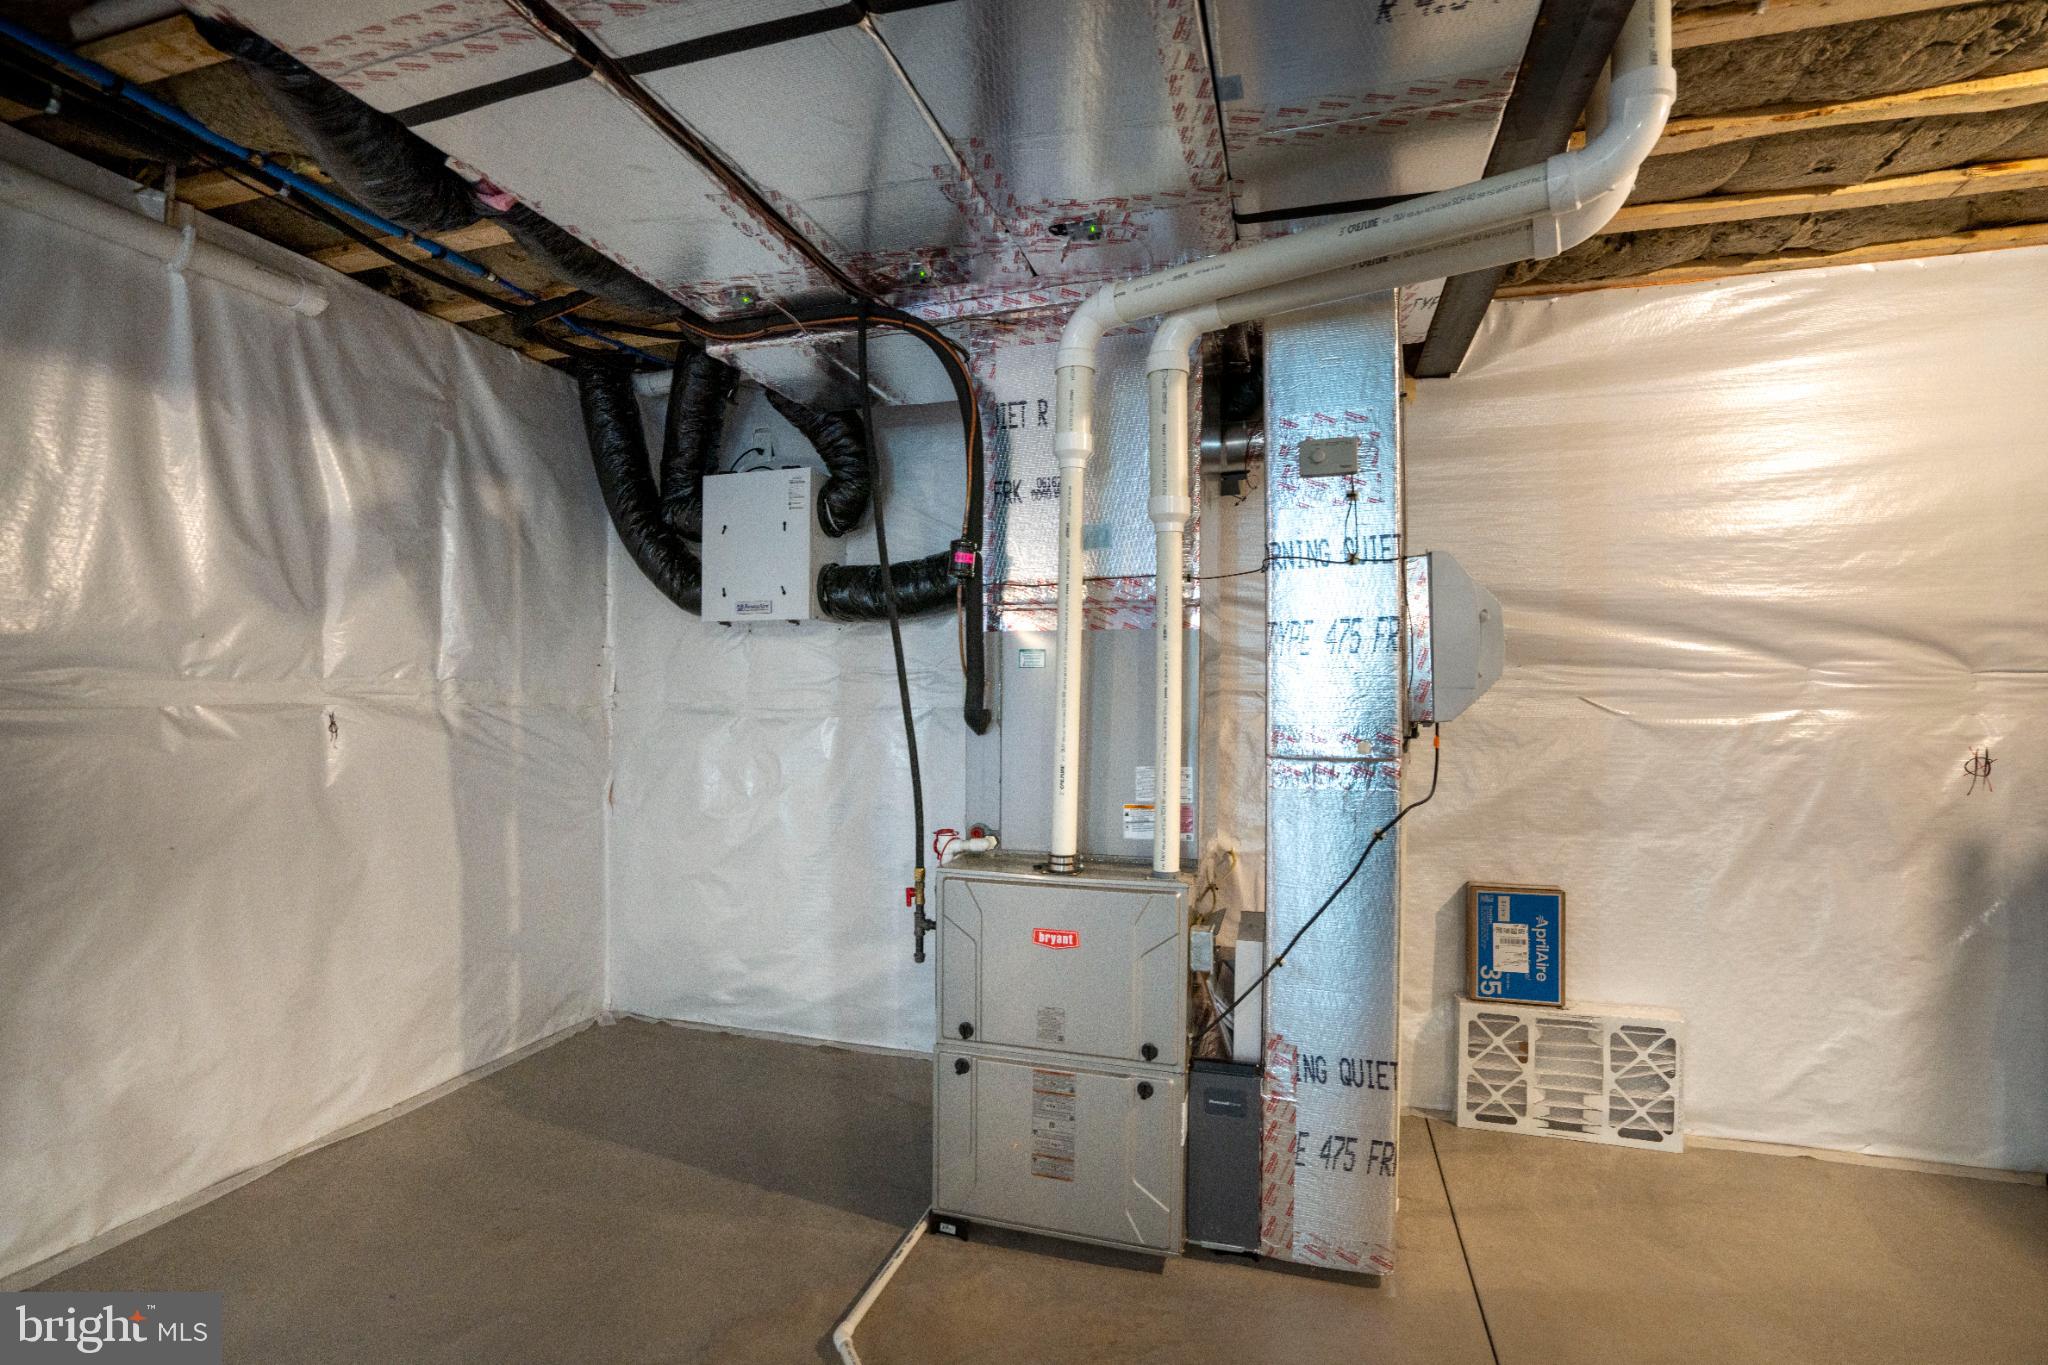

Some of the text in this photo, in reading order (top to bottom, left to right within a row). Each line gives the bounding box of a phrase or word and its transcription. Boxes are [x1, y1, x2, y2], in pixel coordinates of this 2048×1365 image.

[1324, 617, 1363, 655] 475
[1038, 931, 1074, 945] bryant
[1531, 919, 1550, 982] AprilAire
[1480, 965, 1503, 995] 35
[1339, 1057, 1398, 1092] QUIET
[1319, 1134, 1359, 1172] 475
